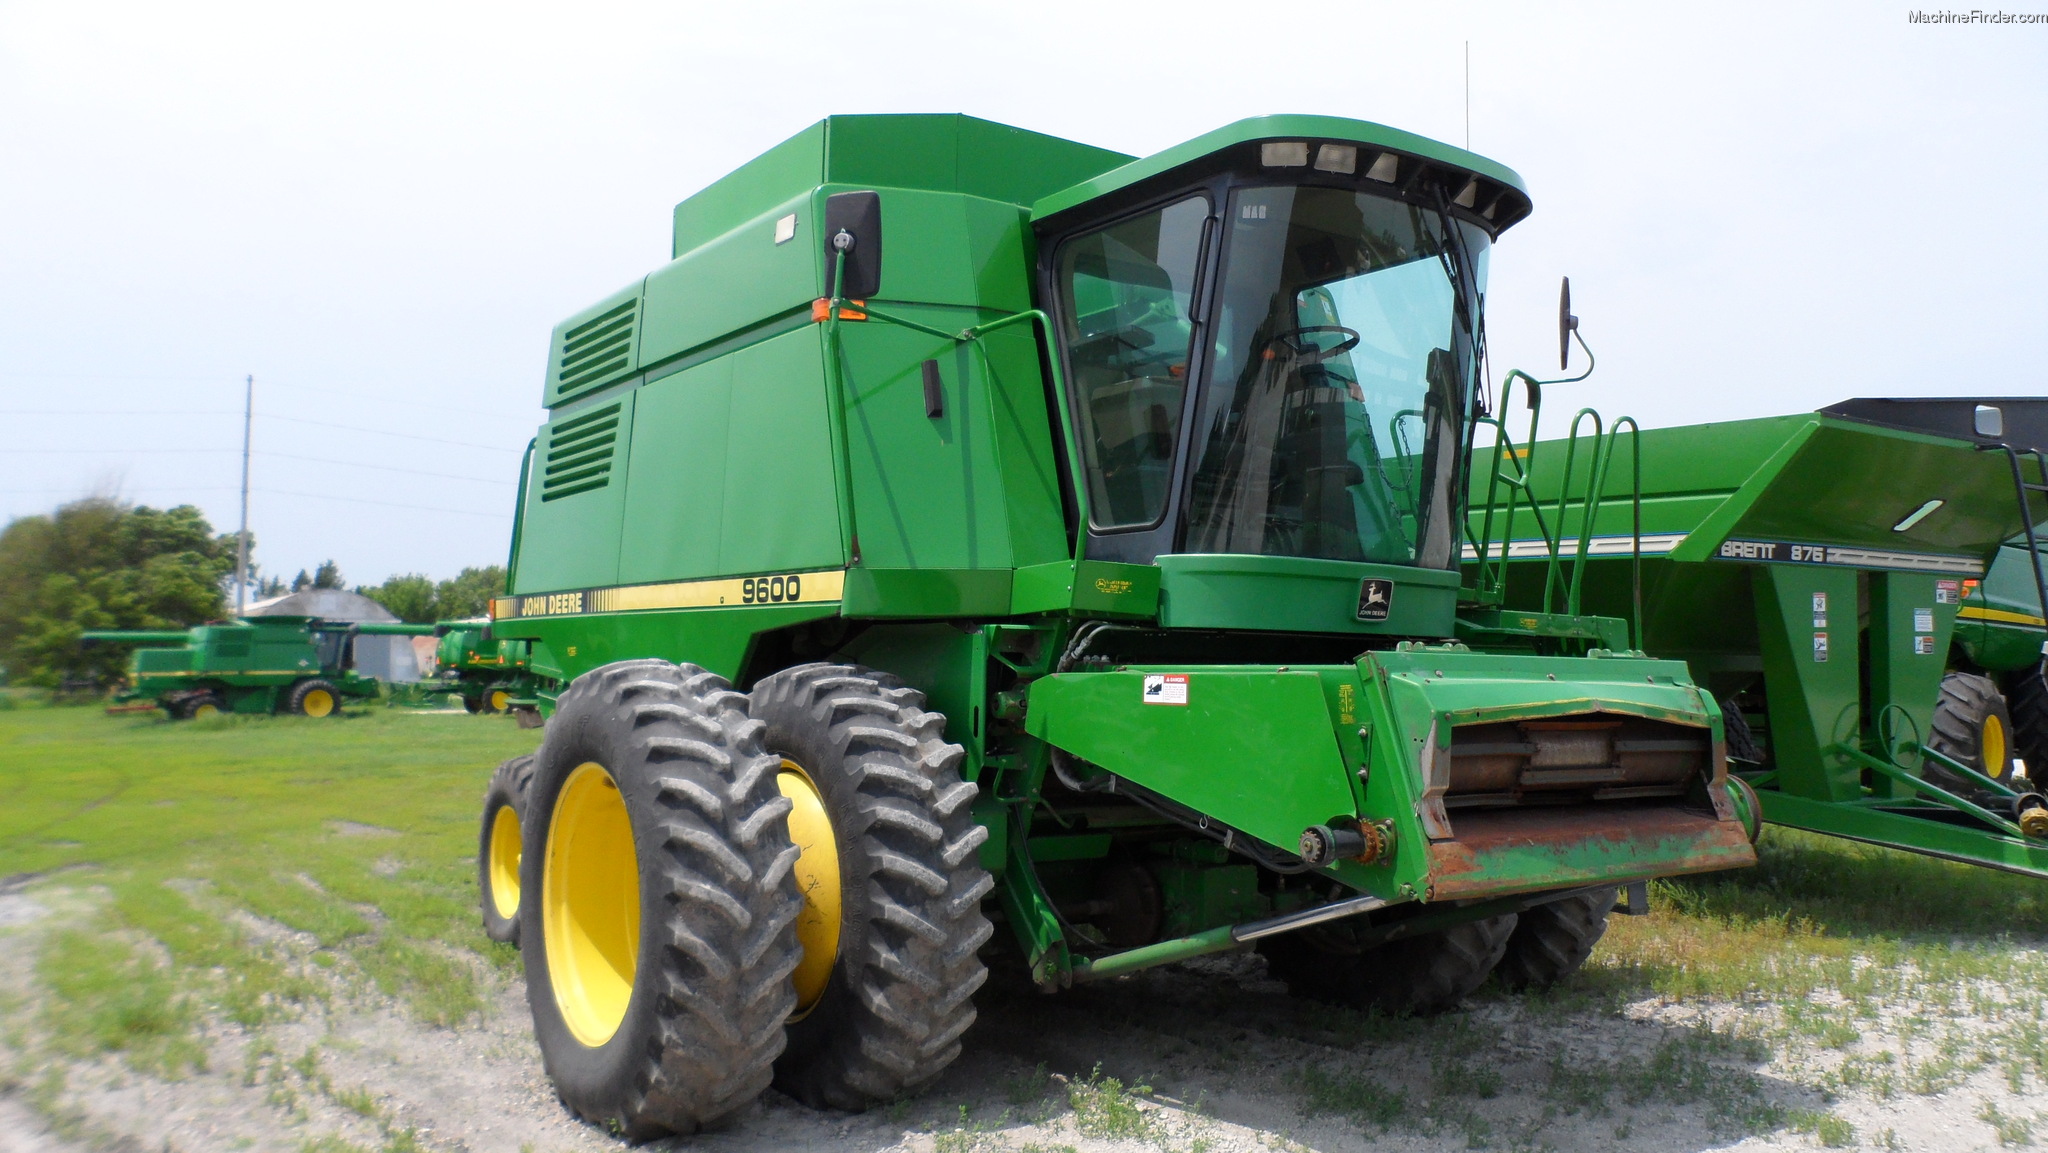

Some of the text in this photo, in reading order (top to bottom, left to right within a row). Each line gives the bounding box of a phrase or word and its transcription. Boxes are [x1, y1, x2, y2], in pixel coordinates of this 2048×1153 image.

[1720, 540, 1776, 559] BRENT
[742, 575, 801, 604] 9600
[521, 592, 583, 617] JOHN DEERE
[1359, 609, 1372, 617] JOHN
